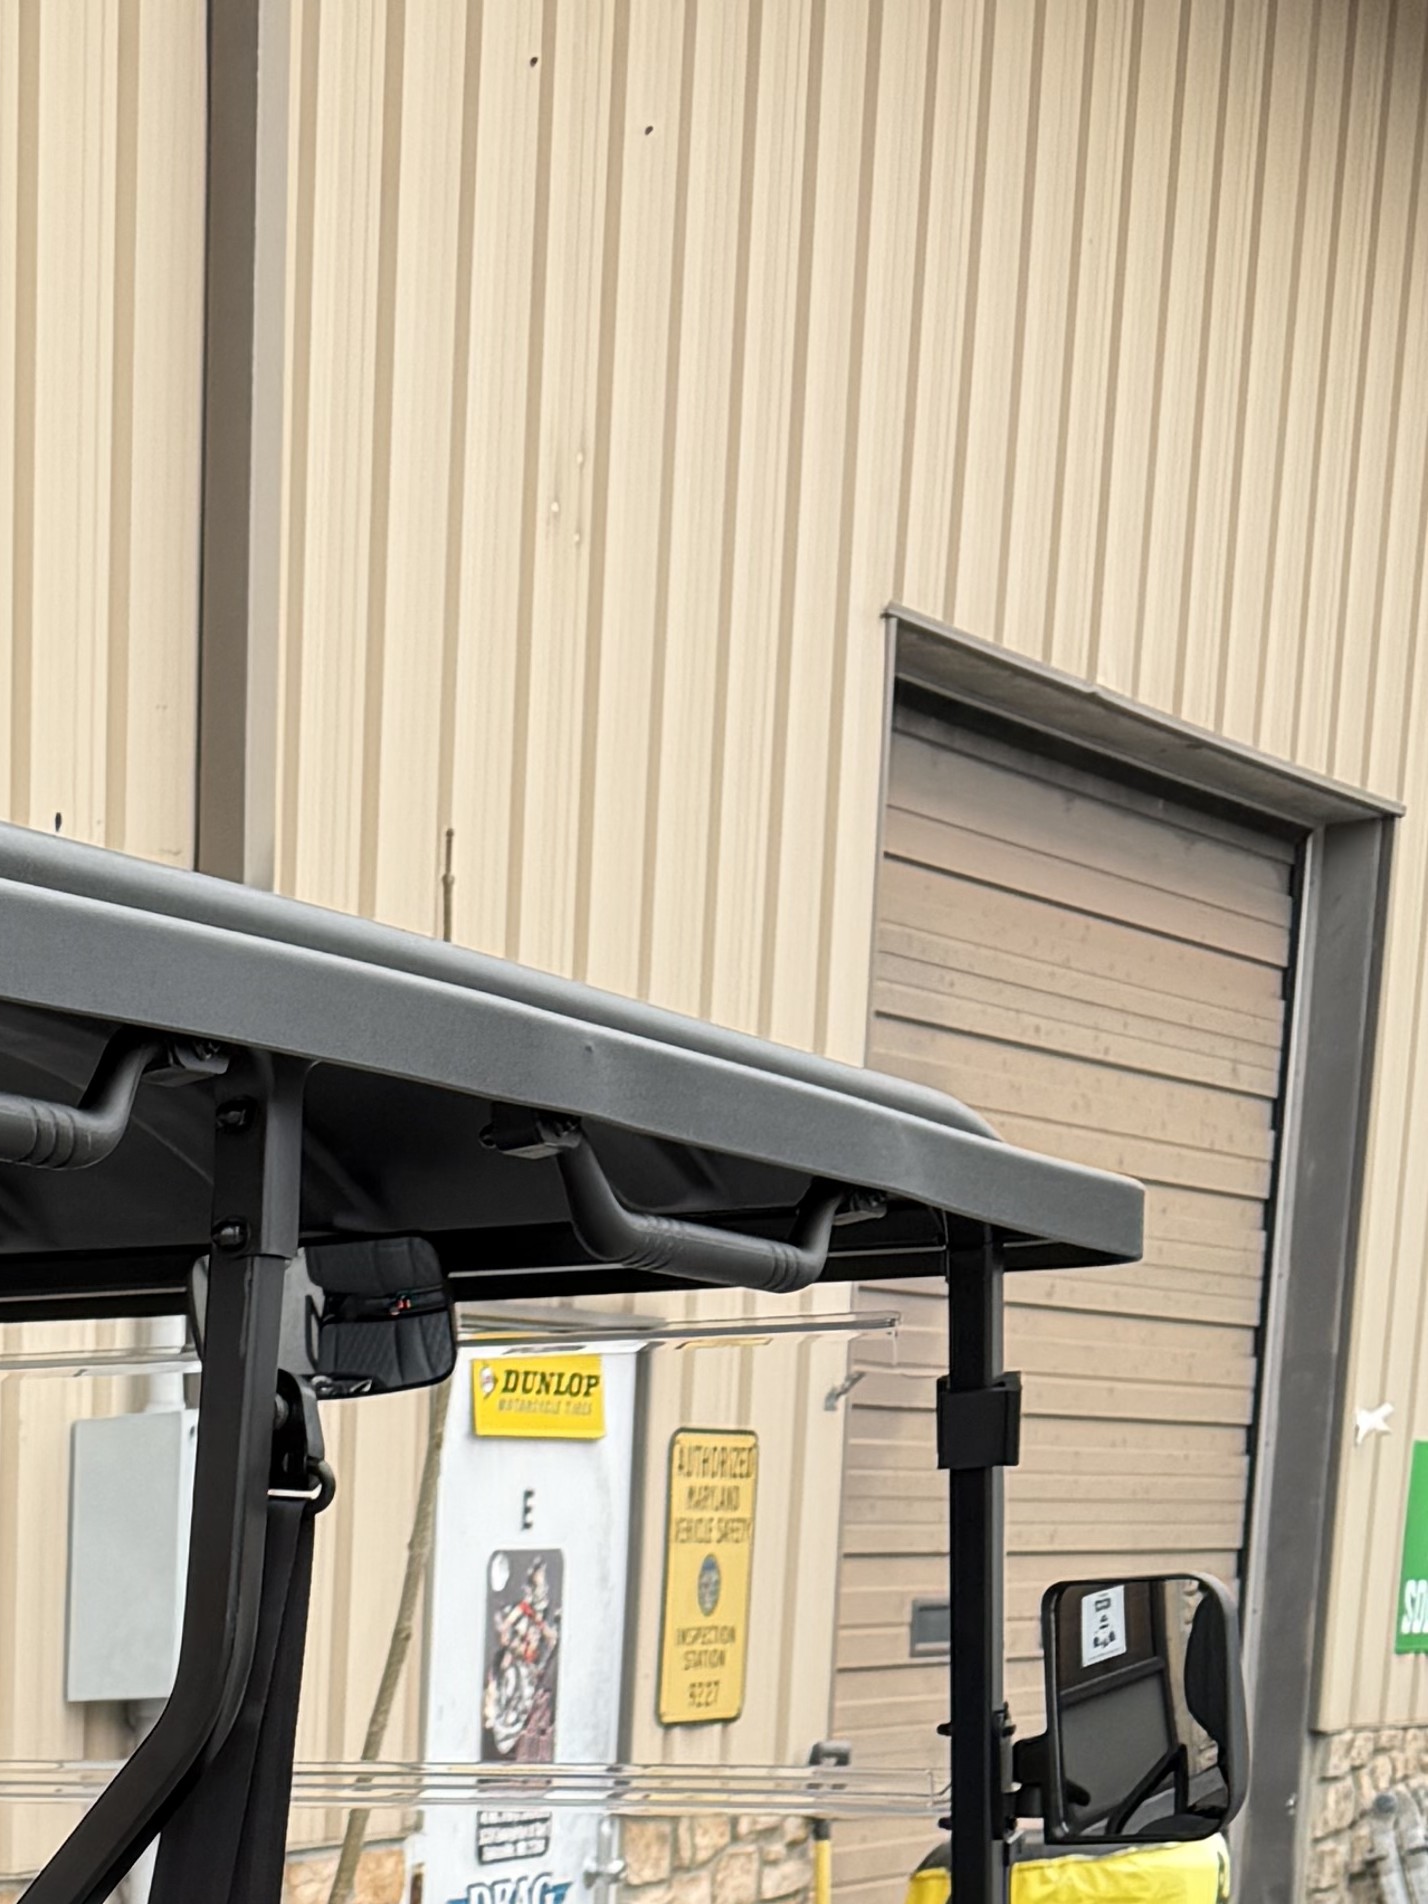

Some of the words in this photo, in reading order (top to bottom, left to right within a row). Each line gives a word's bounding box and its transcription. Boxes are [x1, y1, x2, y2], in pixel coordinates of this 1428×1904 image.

[501, 1369, 601, 1398] DUNLOP
[677, 1445, 754, 1479] AUTHORIZED
[520, 1488, 535, 1531] E
